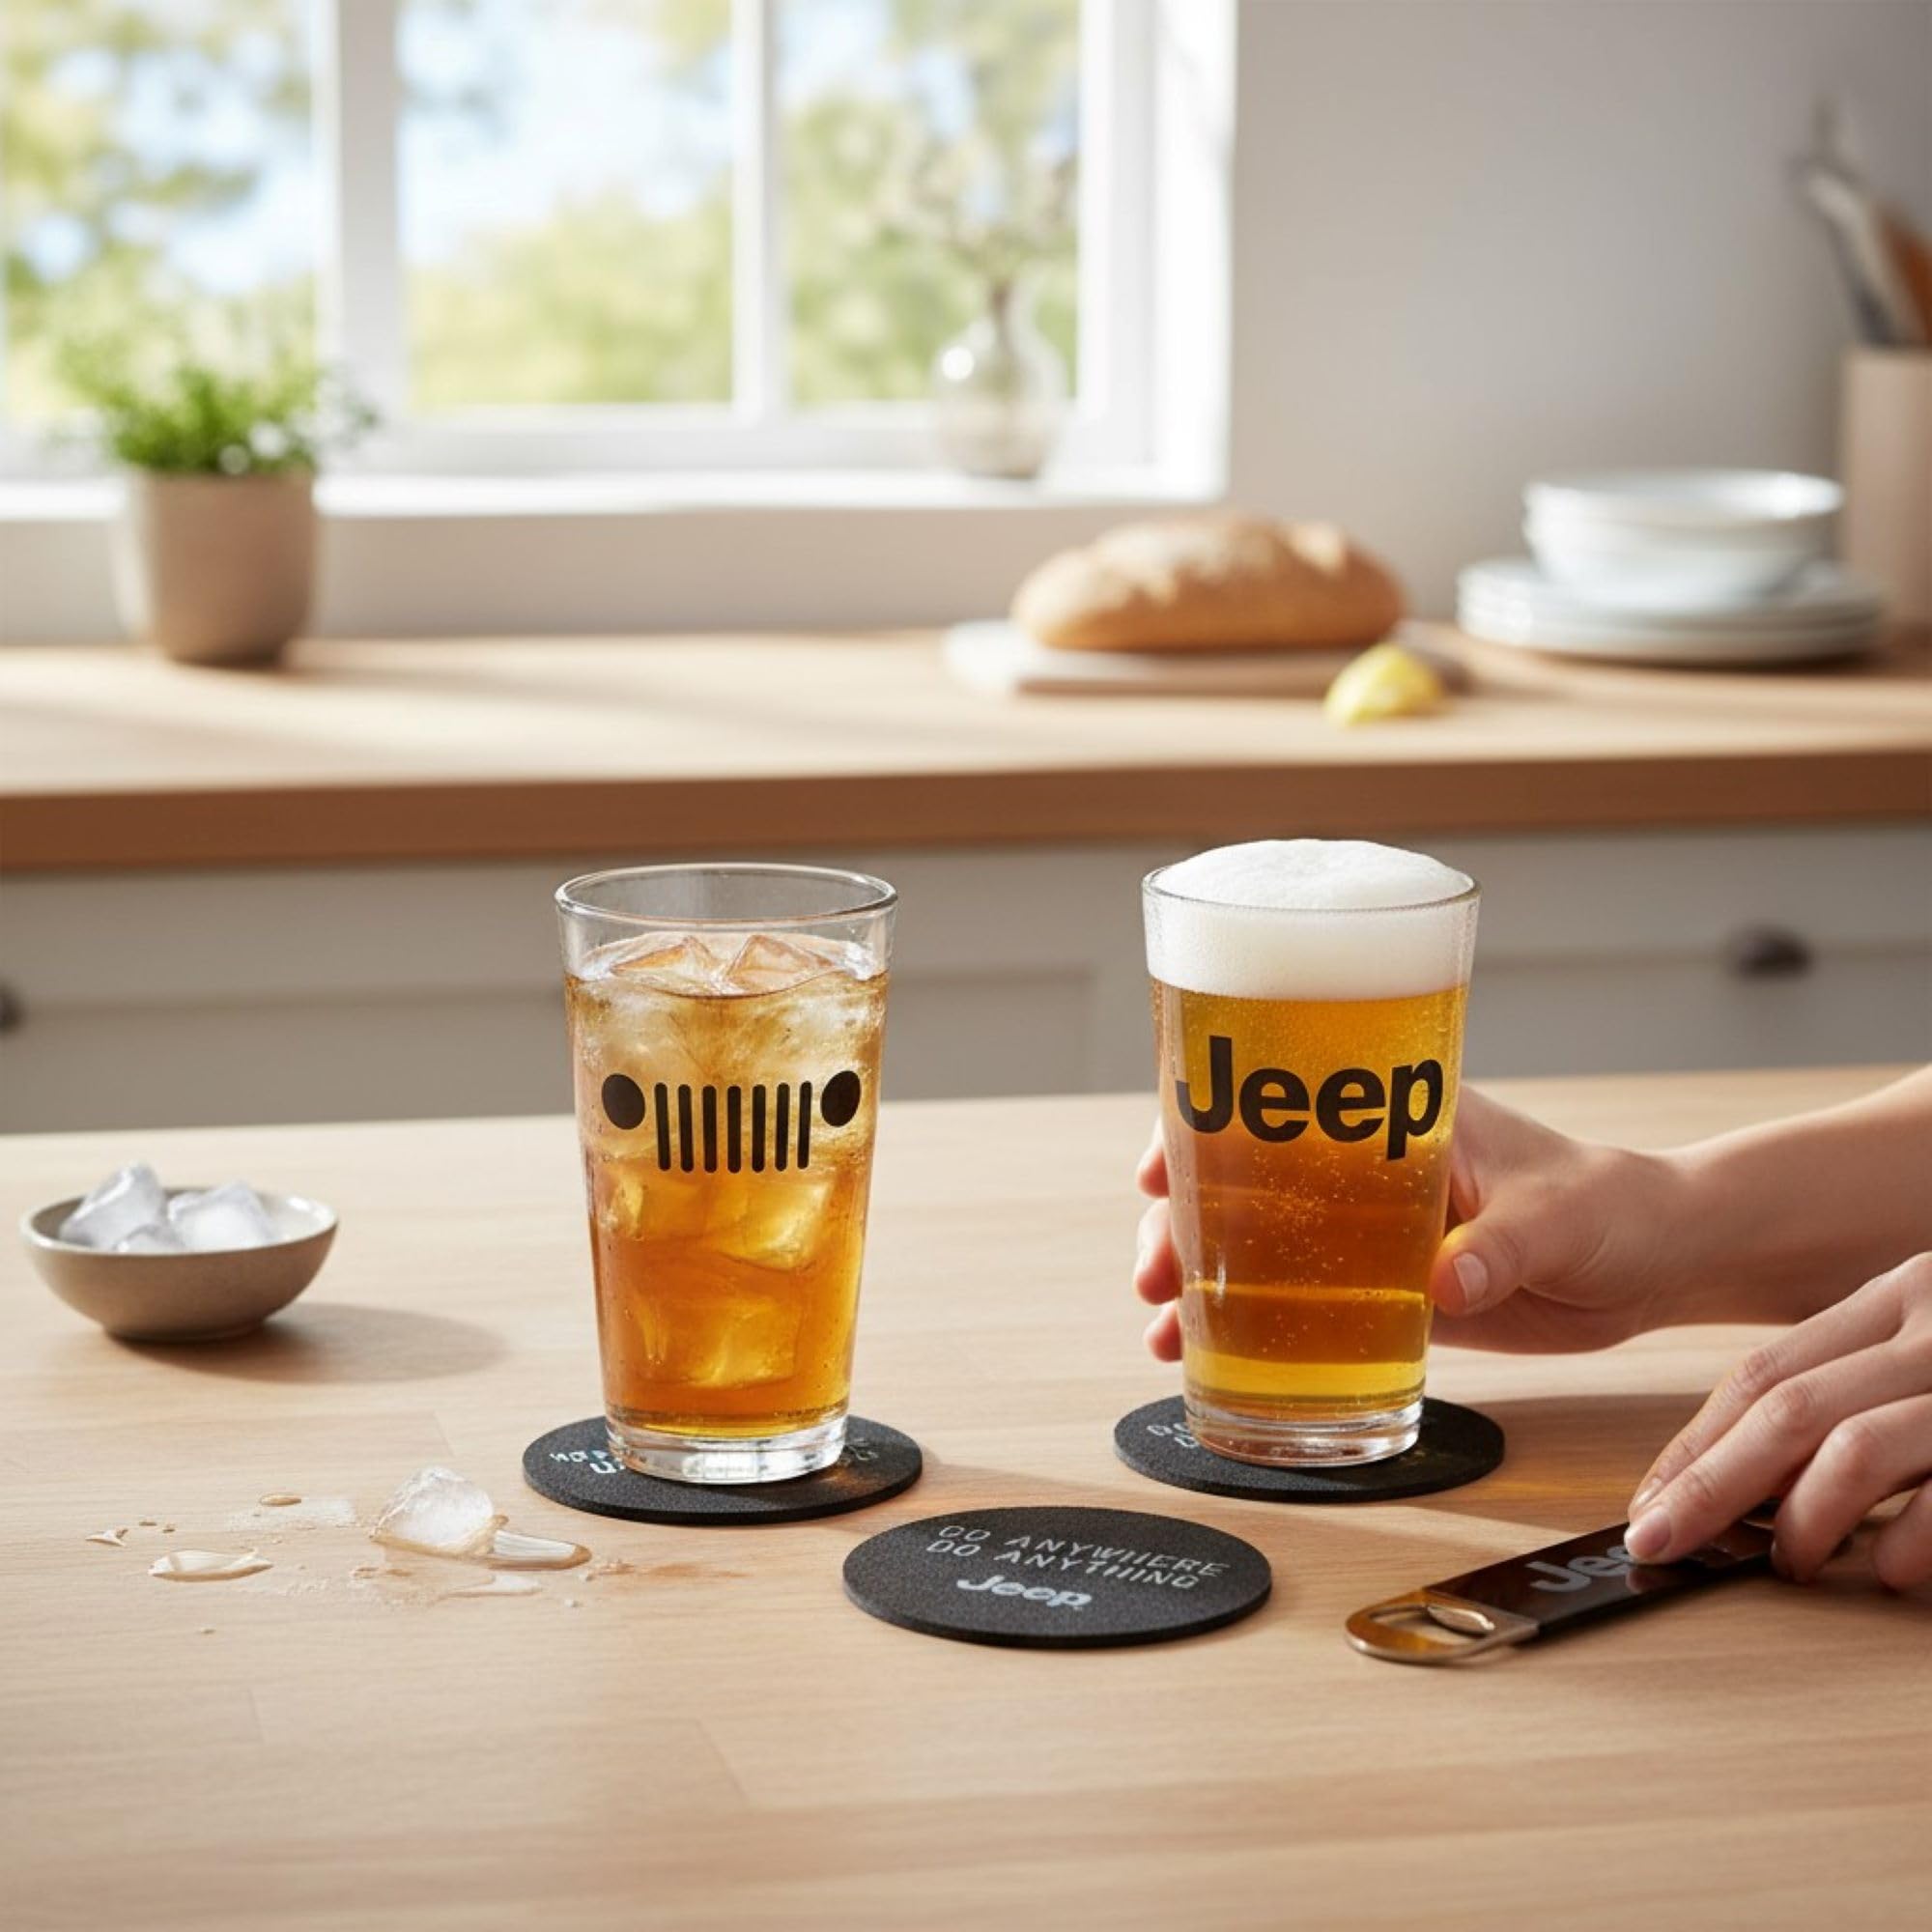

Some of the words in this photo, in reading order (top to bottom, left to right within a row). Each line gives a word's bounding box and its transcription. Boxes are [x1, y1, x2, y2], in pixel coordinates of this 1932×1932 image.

[1175, 1035, 1443, 1160] Jeep
[926, 1539, 981, 1557] DO
[1005, 1535, 1231, 1577] ANYWHERE
[1526, 1546, 1630, 1593] Jee
[956, 1575, 1093, 1607] Jeep
